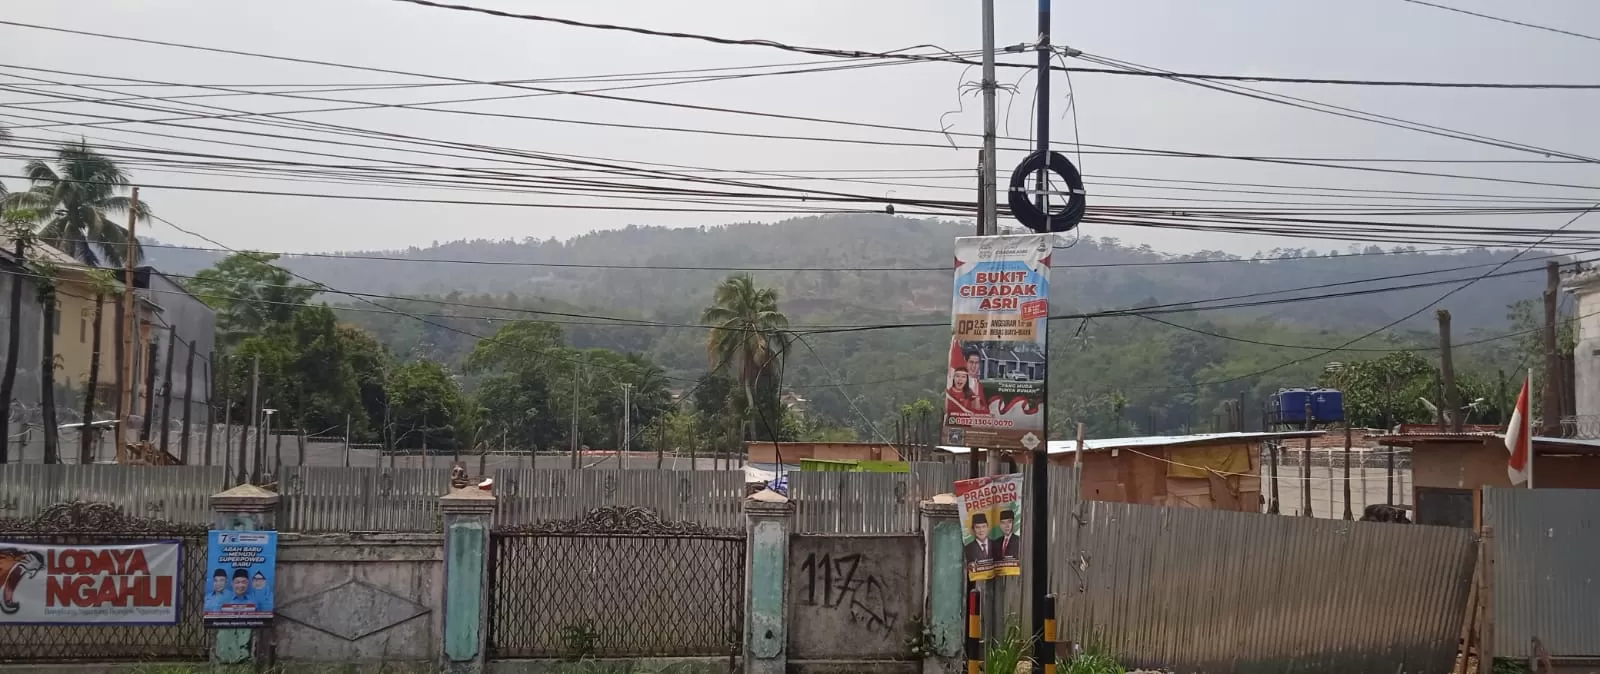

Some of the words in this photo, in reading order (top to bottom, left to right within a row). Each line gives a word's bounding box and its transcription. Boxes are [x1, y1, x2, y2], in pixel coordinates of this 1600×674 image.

[976, 271, 1027, 284] BUKIT
[960, 284, 1037, 297] CIBADAK
[979, 297, 1018, 309] ASRI
[958, 320, 973, 335] DP
[956, 417, 973, 425] 0812
[963, 482, 1016, 501] PRABOWO
[965, 492, 1017, 512] PRESIDEN
[47, 549, 151, 575] LODAYA
[46, 575, 173, 607] NGAHUI
